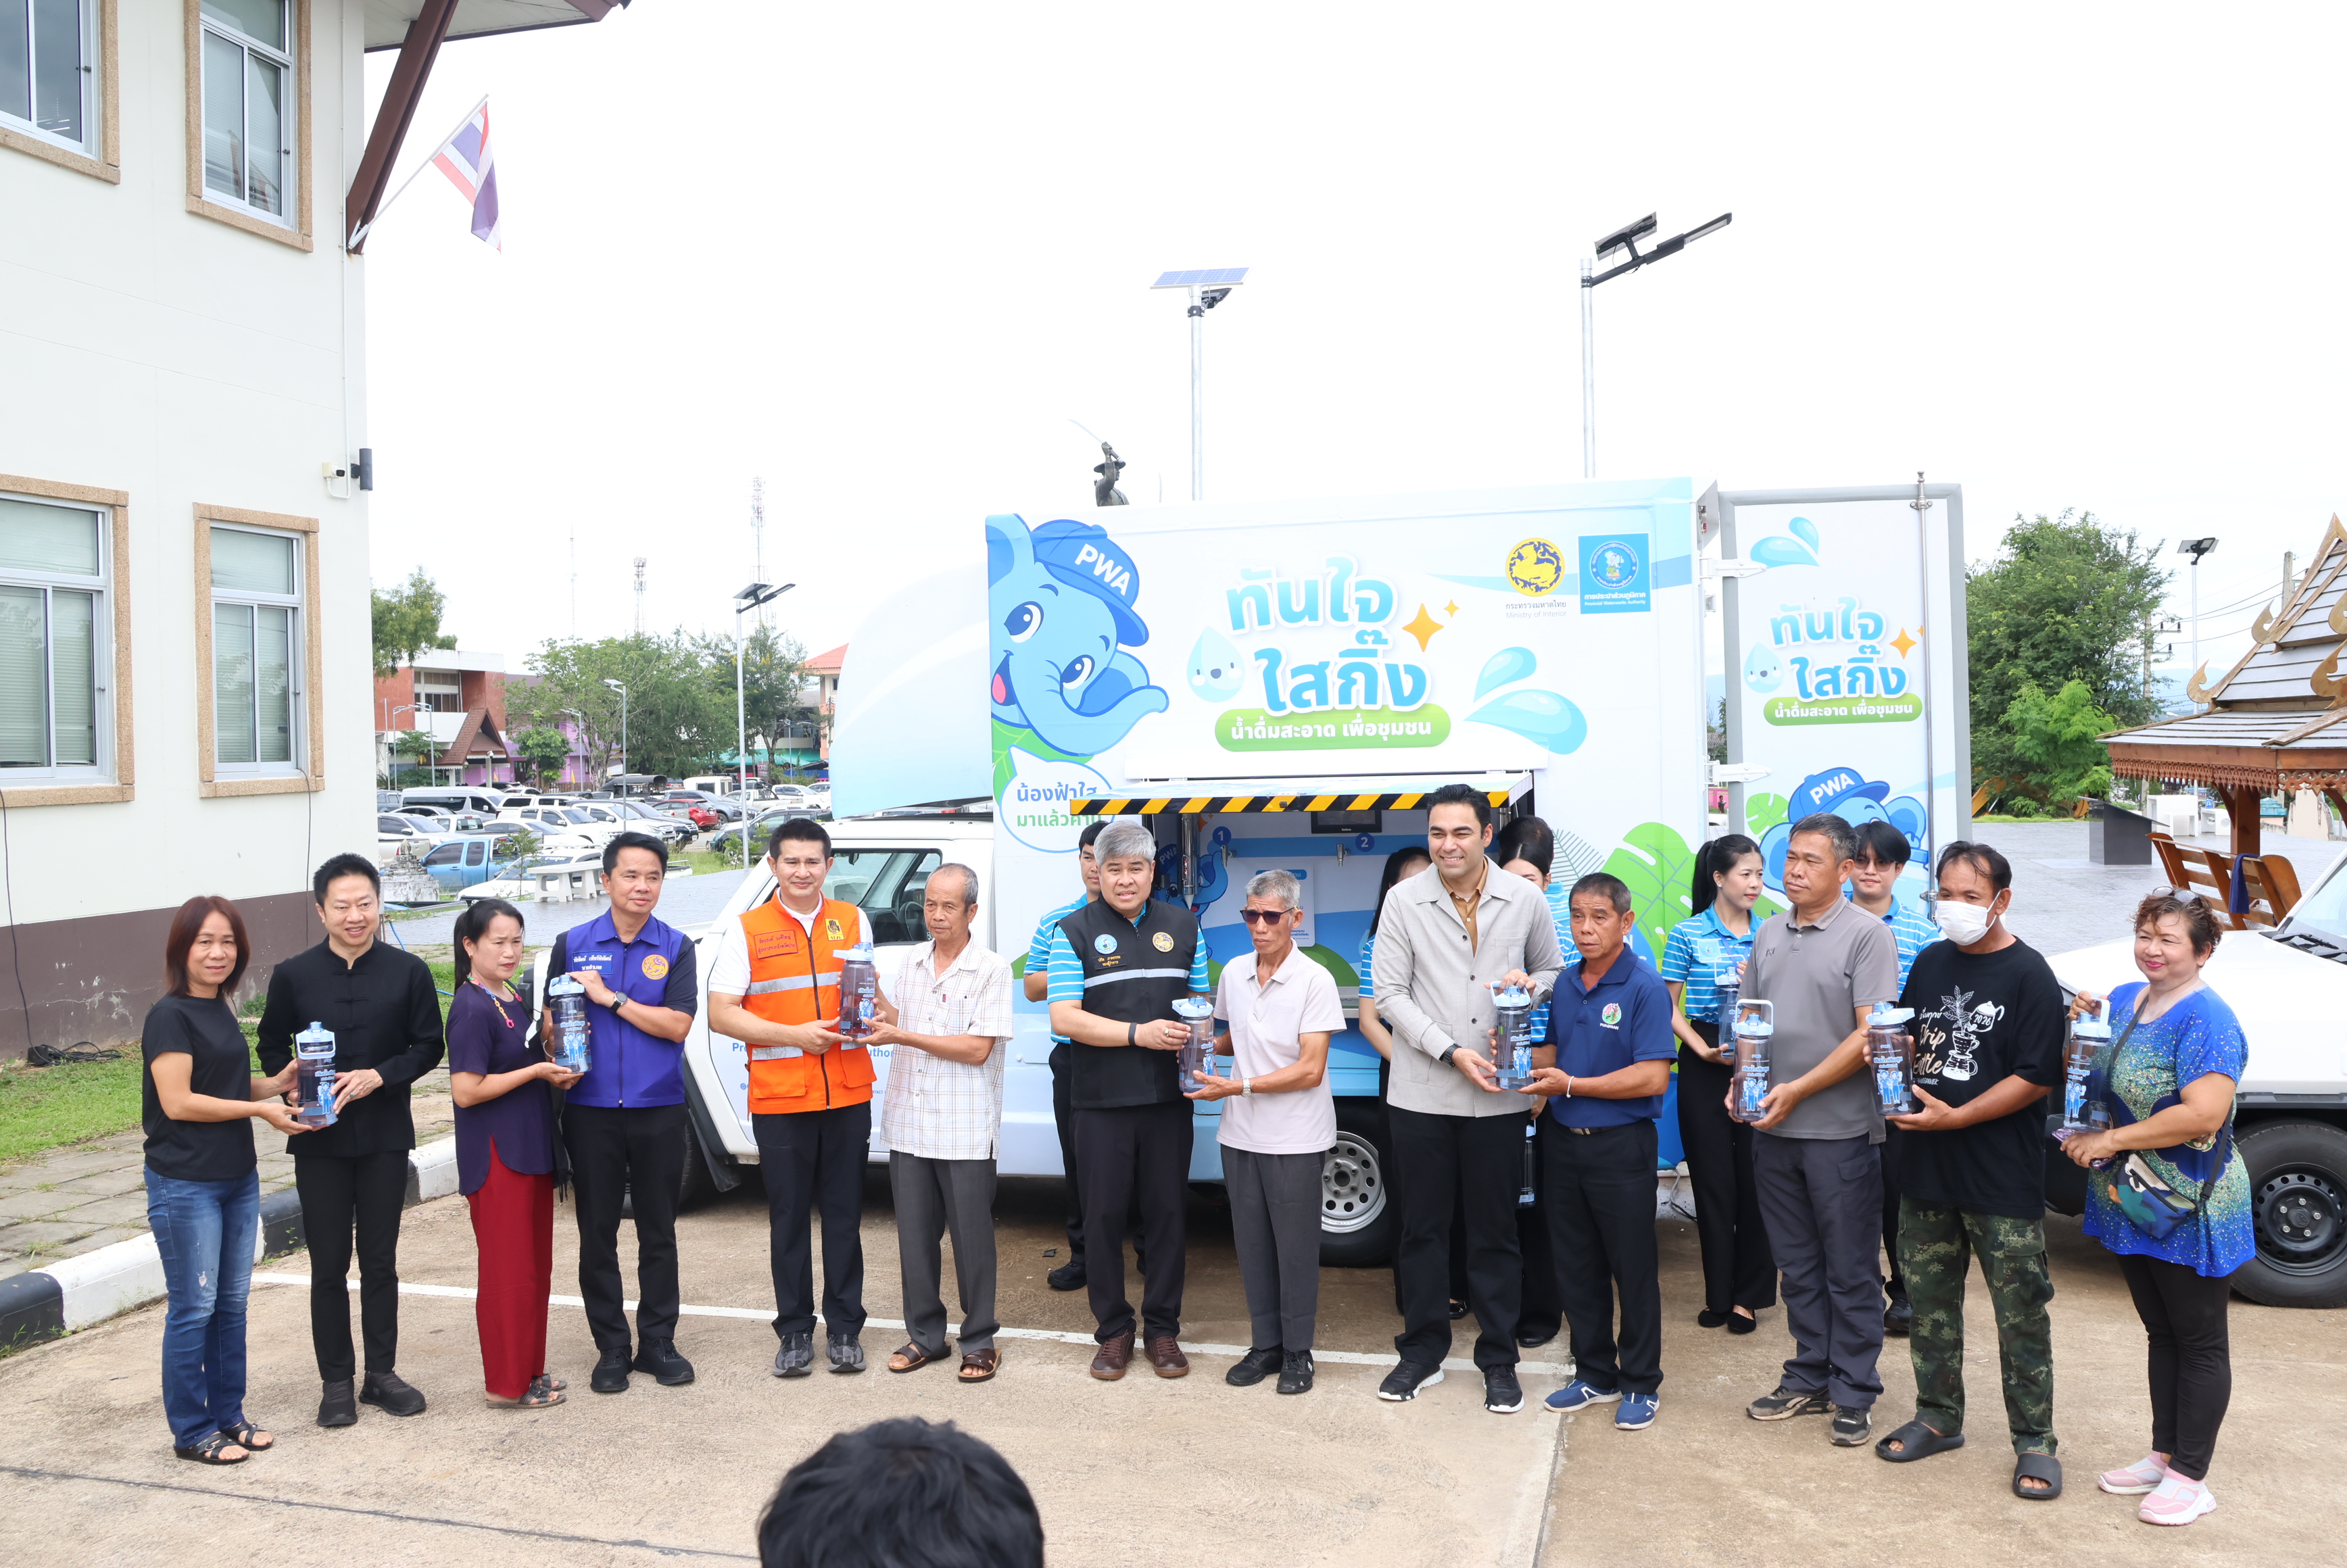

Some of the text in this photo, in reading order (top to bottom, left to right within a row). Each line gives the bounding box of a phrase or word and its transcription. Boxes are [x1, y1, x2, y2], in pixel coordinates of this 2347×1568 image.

[1075, 543, 1133, 597] PWA
[1226, 557, 1395, 631] ทันใจ
[1505, 599, 1567, 609] กระทรวงมหาดไทย
[1584, 591, 1646, 601] การประปาส่วนภูมิภาค
[1769, 596, 1885, 646] ทันใจ
[1254, 629, 1427, 713] ใสกิ๊ง
[1789, 645, 1907, 699] ใสกิ๊ง
[1774, 700, 1913, 718] น้ำดื่มสะอาด เพื่อชุมชน
[1231, 713, 1432, 741] น้ำดื่มสะอาด เพื่อชุมชน
[1809, 772, 1856, 805] PWA
[1218, 831, 1224, 841] 1
[1361, 837, 1369, 848] 2
[1974, 1014, 1991, 1026] 2026
[1920, 1024, 1946, 1051] Drip
